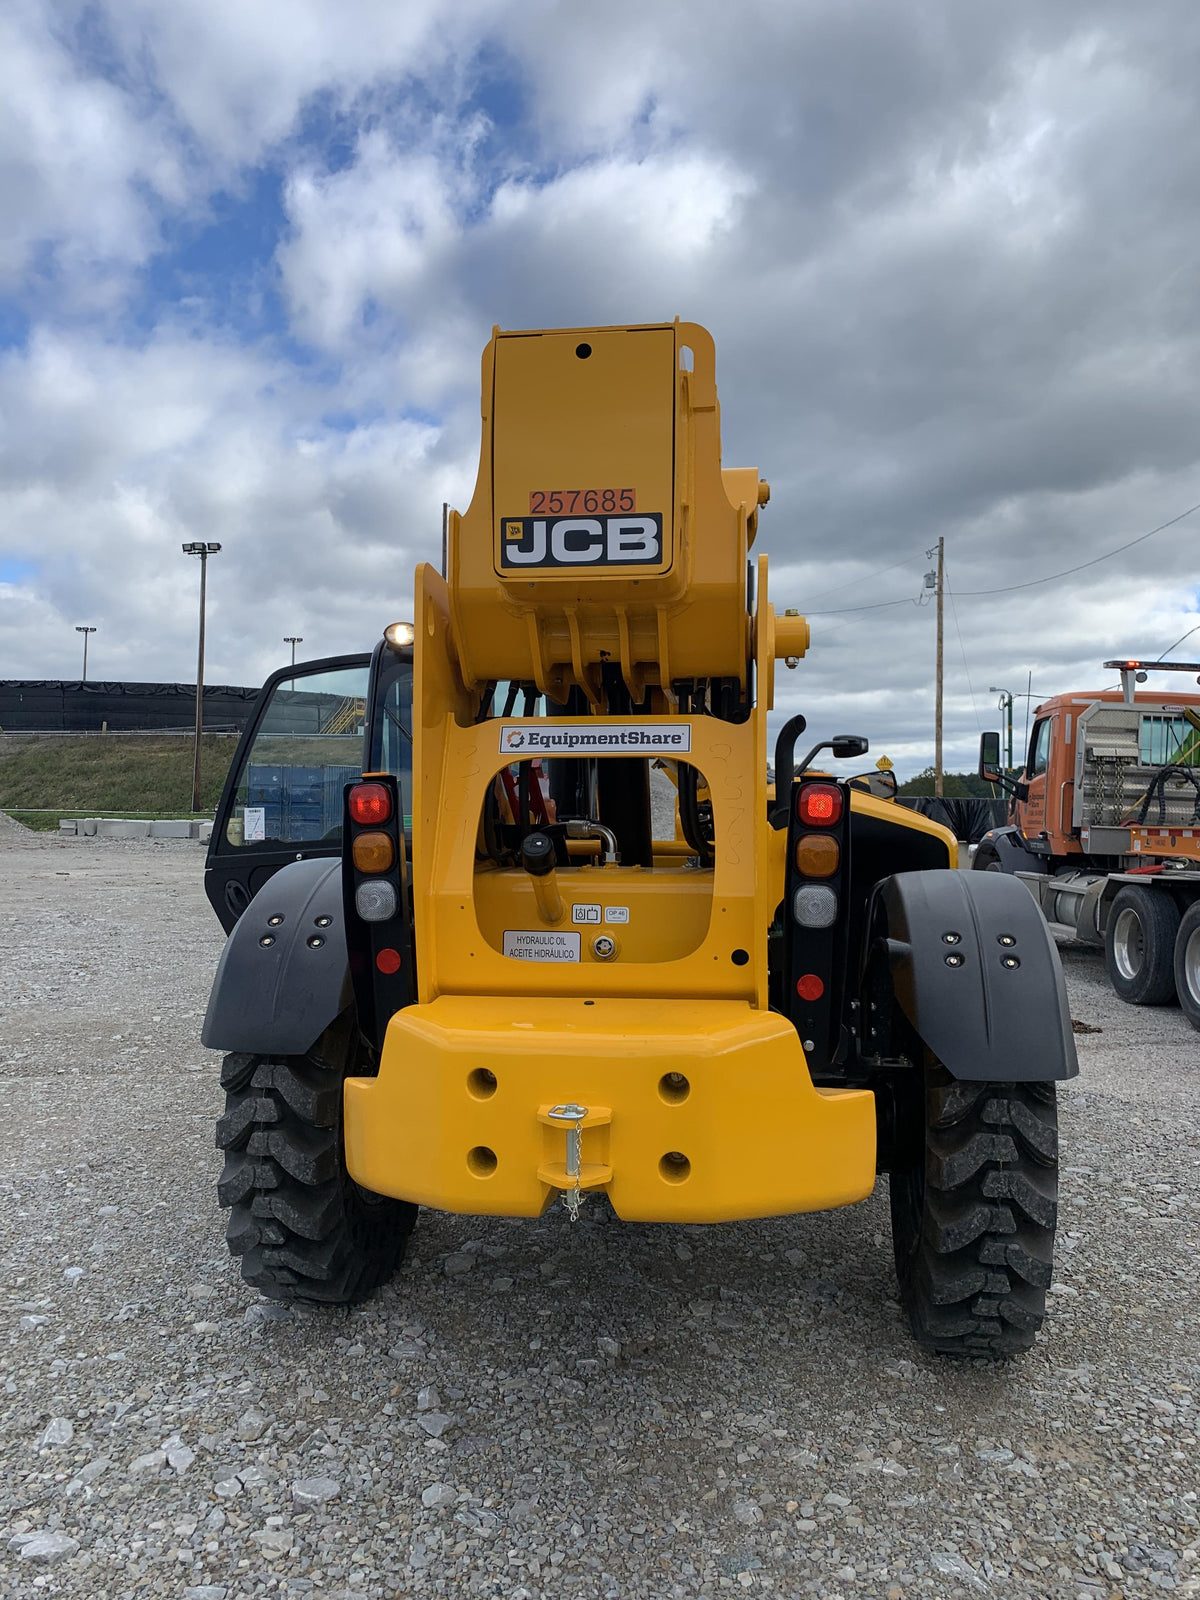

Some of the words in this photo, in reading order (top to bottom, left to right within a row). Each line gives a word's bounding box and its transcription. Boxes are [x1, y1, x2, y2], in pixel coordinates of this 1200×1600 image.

[531, 489, 634, 513] 257685
[506, 517, 659, 564] JCB
[528, 731, 682, 748] EquipmentShare
[516, 935, 554, 945] HYDRAULIC
[555, 937, 567, 945] OIL
[509, 948, 533, 958] ACEITE
[534, 947, 574, 958] HIDRÁULICO
